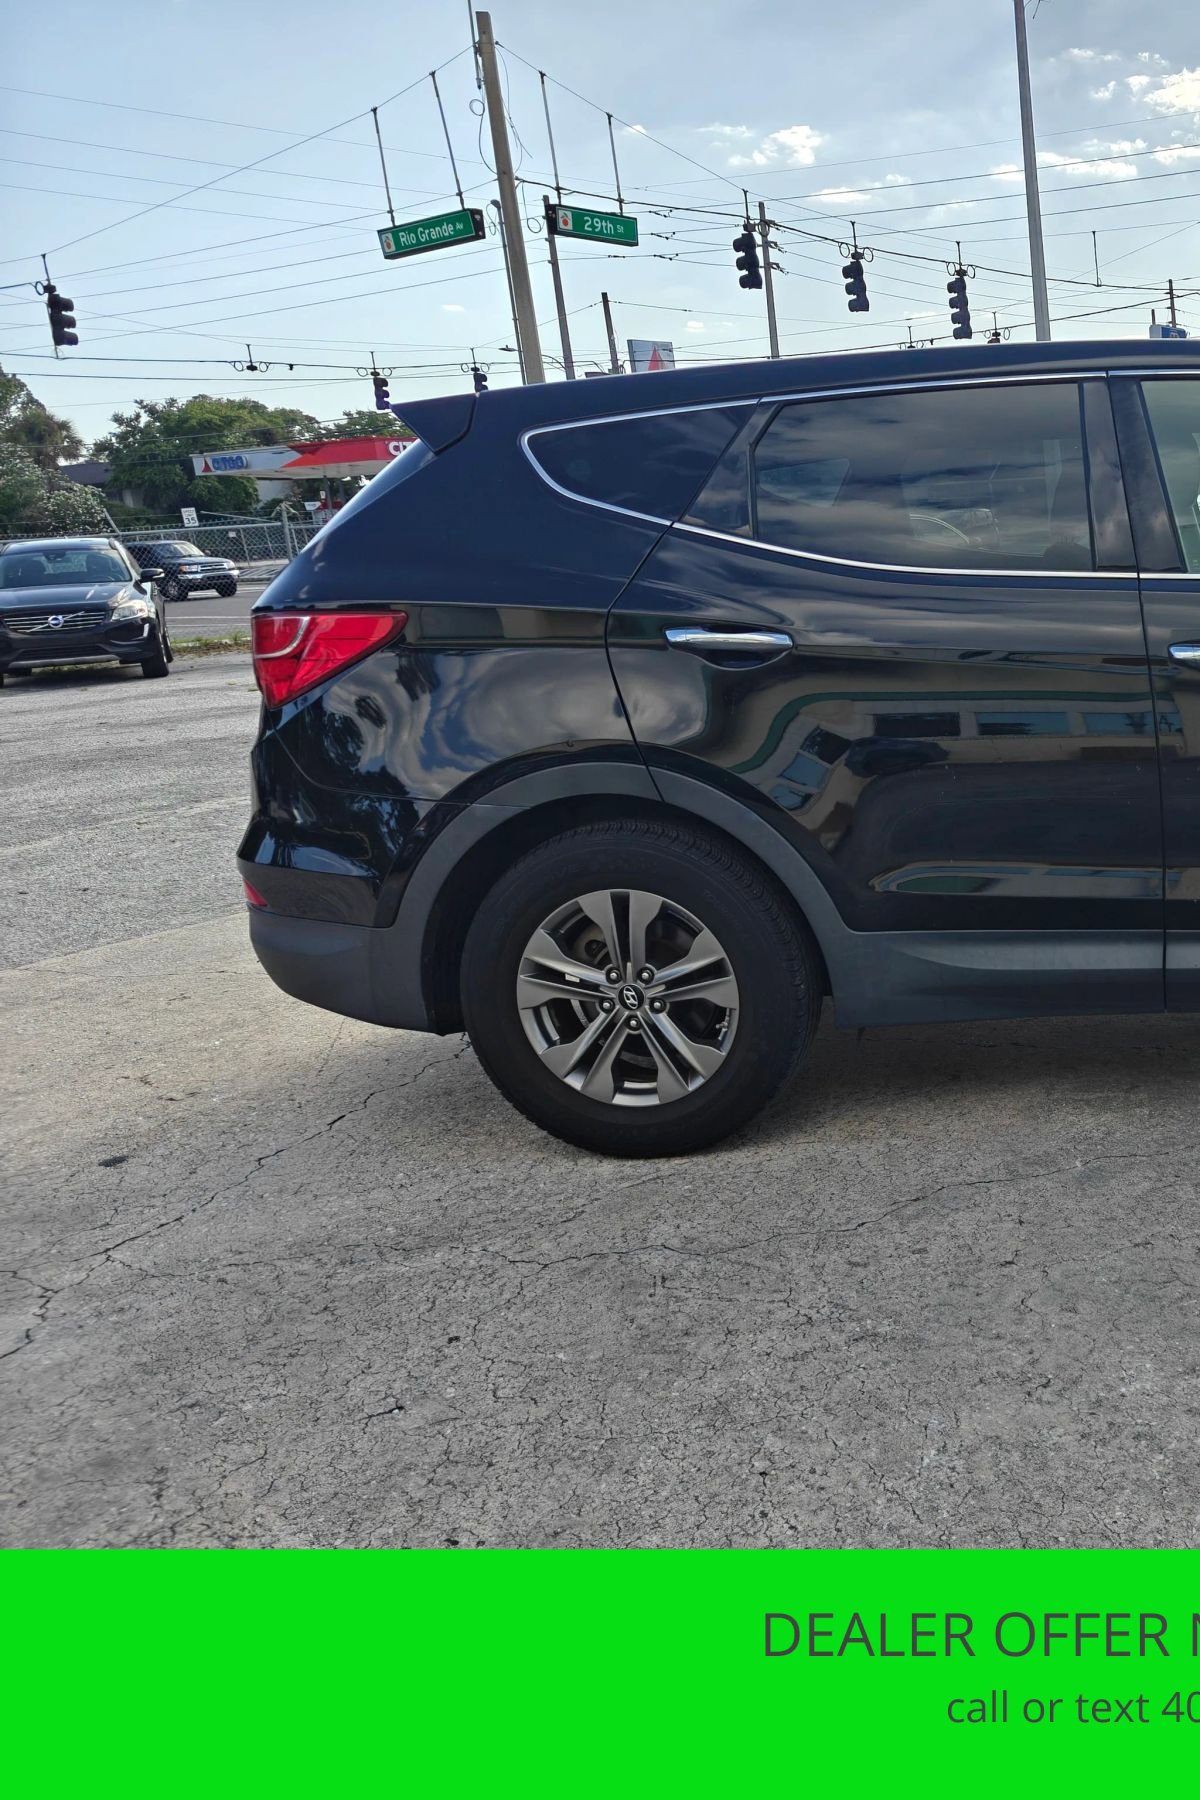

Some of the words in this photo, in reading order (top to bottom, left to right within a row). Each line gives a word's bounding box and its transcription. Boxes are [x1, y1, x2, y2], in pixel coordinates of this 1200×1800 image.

[399, 231, 416, 247] Rio
[417, 222, 454, 242] Grande
[584, 216, 614, 235] 29th
[616, 225, 624, 233] St
